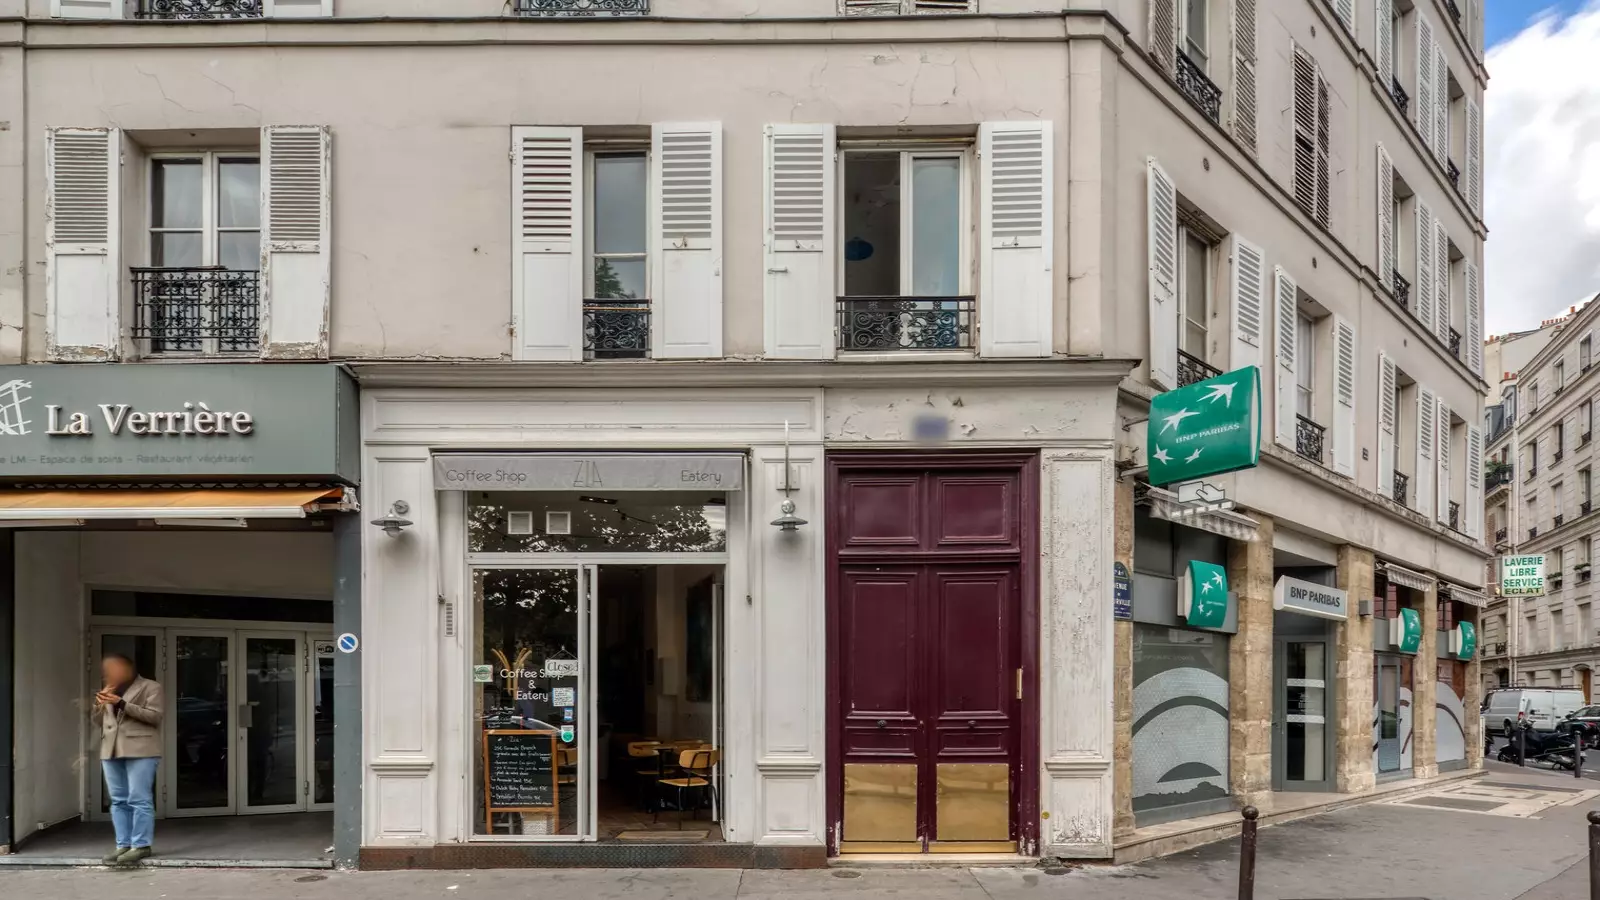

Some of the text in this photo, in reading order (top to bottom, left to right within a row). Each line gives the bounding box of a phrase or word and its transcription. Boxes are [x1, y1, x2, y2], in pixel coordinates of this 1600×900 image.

[44, 401, 253, 436] La Verrière
[1176, 423, 1240, 444] BNP PARIBAS
[11, 455, 26, 464] LM
[40, 455, 76, 466] Espace
[80, 454, 93, 464] de
[98, 454, 123, 465] soins
[136, 454, 192, 464] Restaurant
[446, 470, 527, 484] Coffee Shop
[573, 460, 603, 487] ZIA
[681, 470, 722, 485] Eatery
[1504, 557, 1543, 566] LAVERIE
[1510, 567, 1537, 576] LIBRE
[1503, 577, 1543, 587] SERVICE
[1290, 586, 1341, 608] BNP PARIBAS
[1504, 587, 1541, 595] ECLAT
[547, 661, 578, 672] Closed
[500, 668, 538, 678] Coffee
[528, 680, 536, 689] &
[517, 690, 549, 702] Eatery
